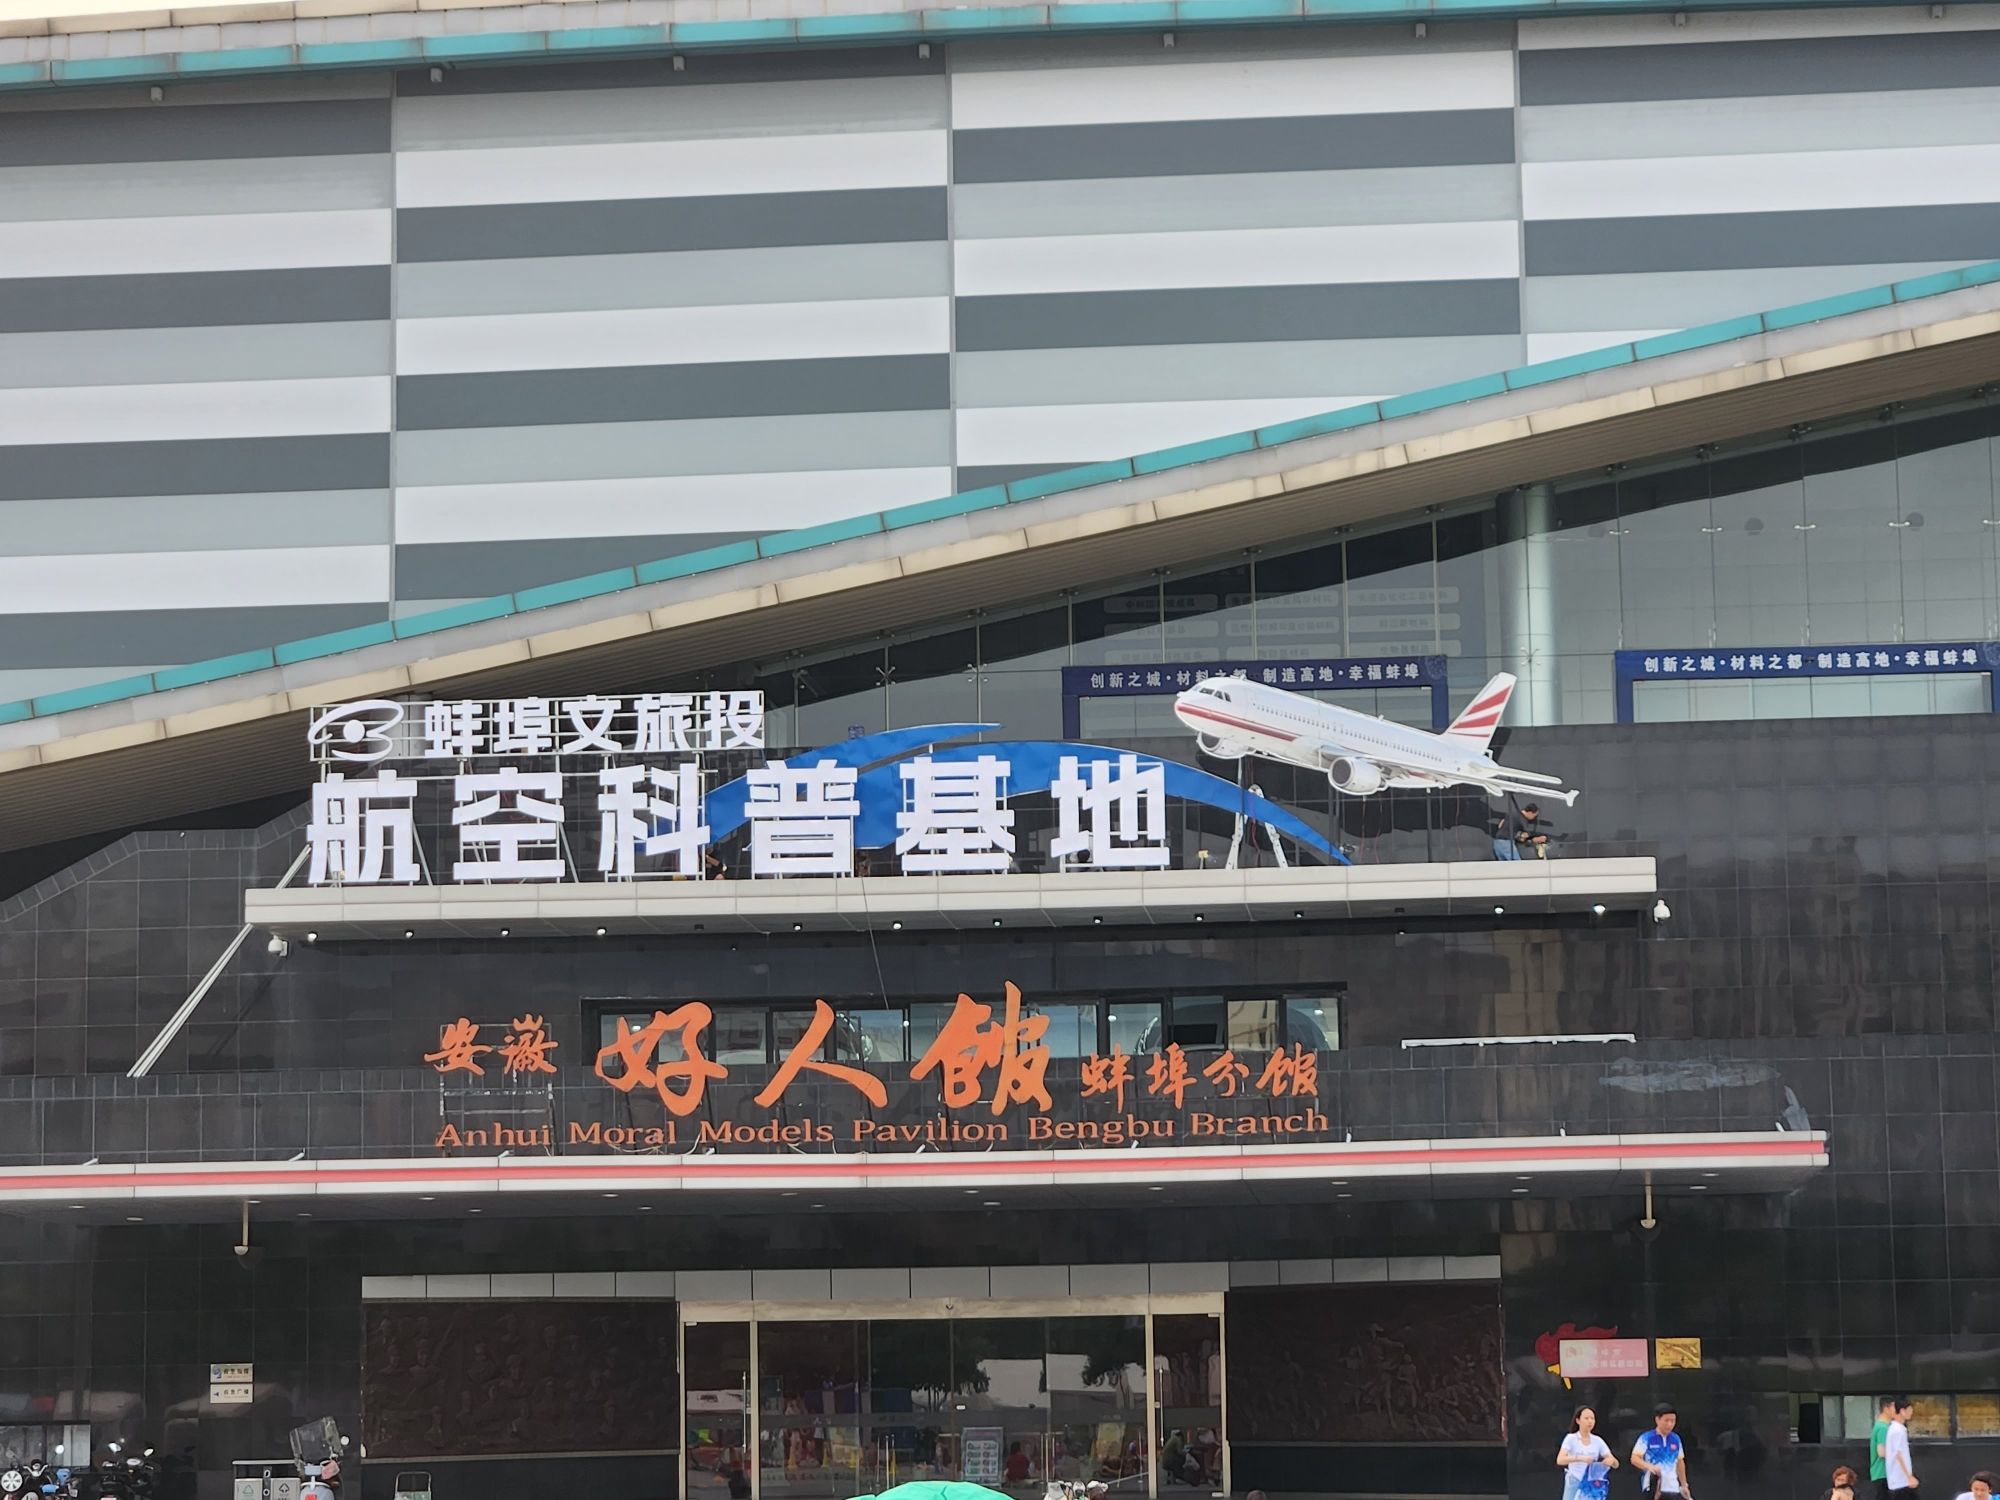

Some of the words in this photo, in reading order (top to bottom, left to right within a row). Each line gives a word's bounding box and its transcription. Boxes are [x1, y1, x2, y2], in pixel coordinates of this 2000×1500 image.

[1263, 663, 1420, 683] 制造高地·幸福蚌埠
[425, 691, 765, 758] 蚌埠文旅投
[307, 754, 1170, 884] 航空科普基地
[436, 1121, 551, 1147] Anhui
[568, 1121, 677, 1146] Moral
[700, 1118, 834, 1144] Models
[853, 1117, 1009, 1142] Pavilion
[1027, 1113, 1175, 1145] Bengbu
[1190, 1108, 1329, 1136] Branch
